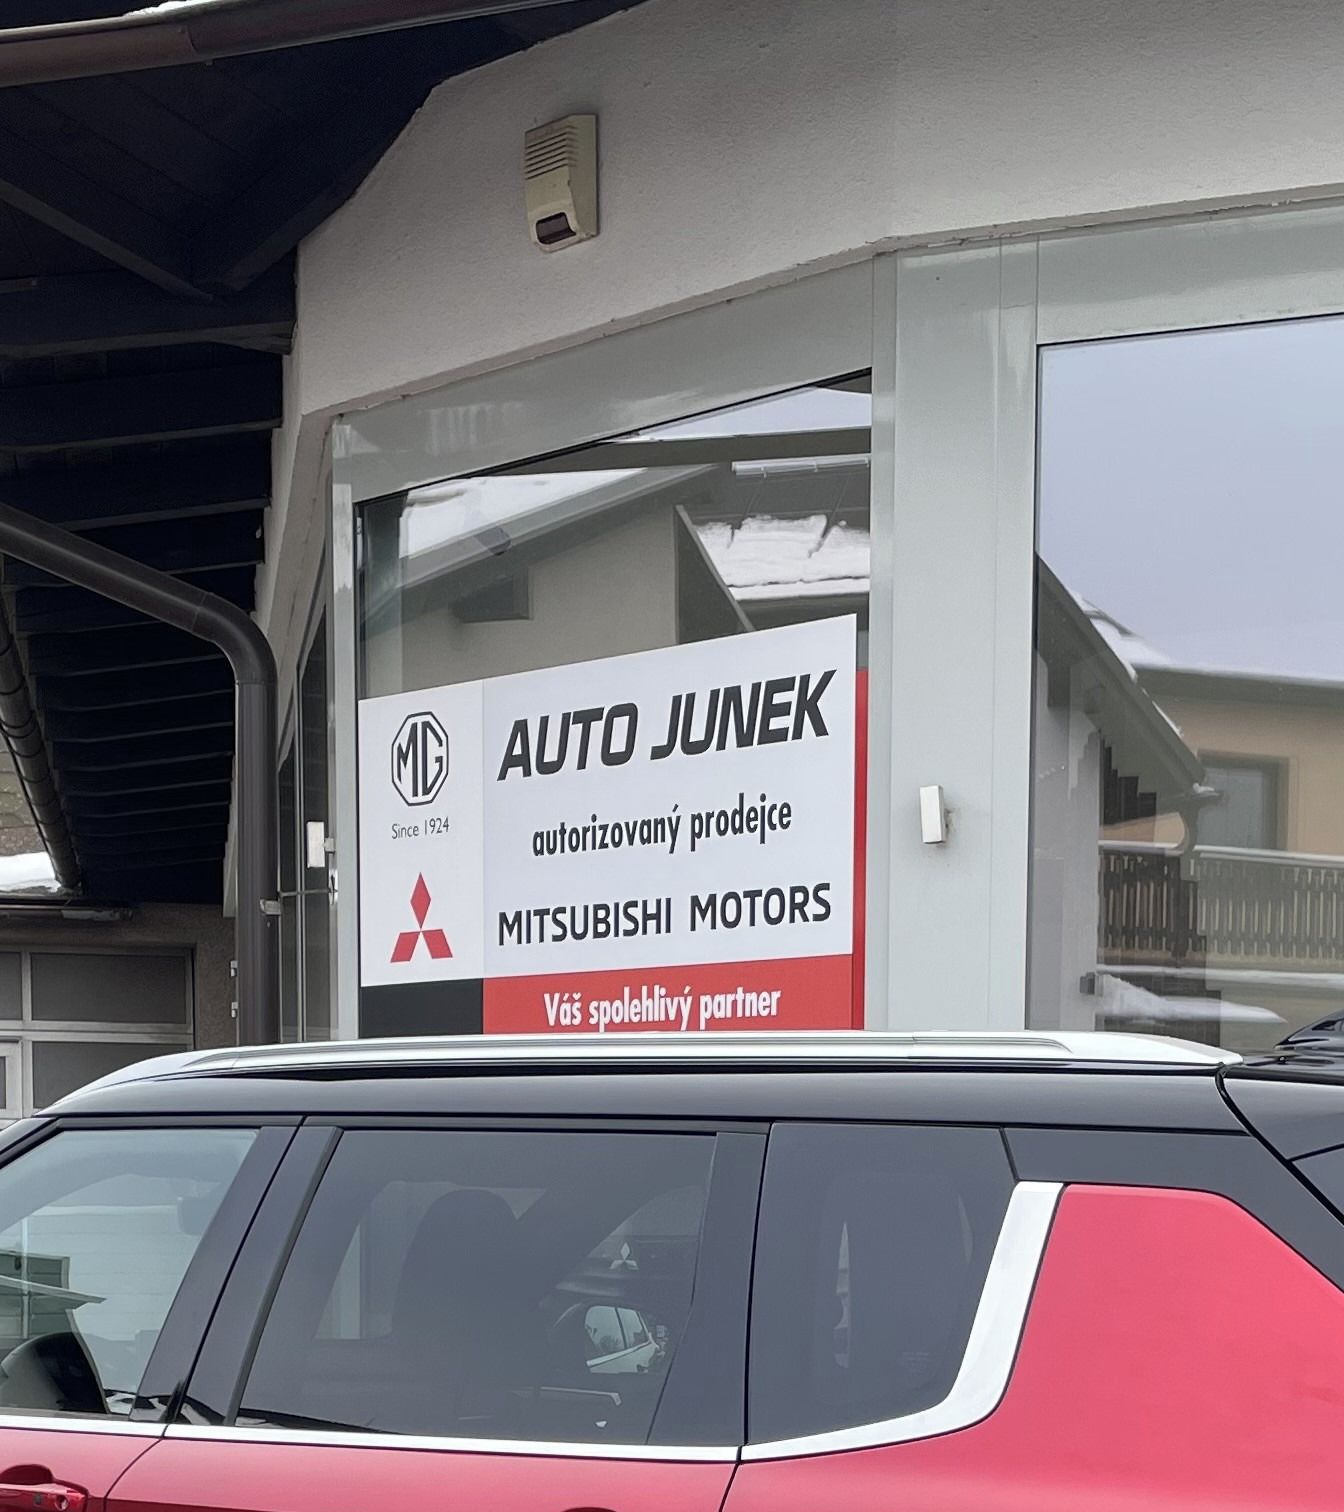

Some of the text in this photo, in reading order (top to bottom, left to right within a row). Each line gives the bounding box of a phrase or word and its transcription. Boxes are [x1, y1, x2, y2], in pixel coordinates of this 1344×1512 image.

[497, 669, 837, 782] AUTO JUNEK
[397, 720, 444, 798] MG
[392, 816, 450, 840] Since 1924
[532, 792, 792, 856] autorizovaný prodejce
[498, 882, 832, 946] MITSUBISHI MOTORS
[543, 985, 781, 1033] Váš spolehlivý partner
